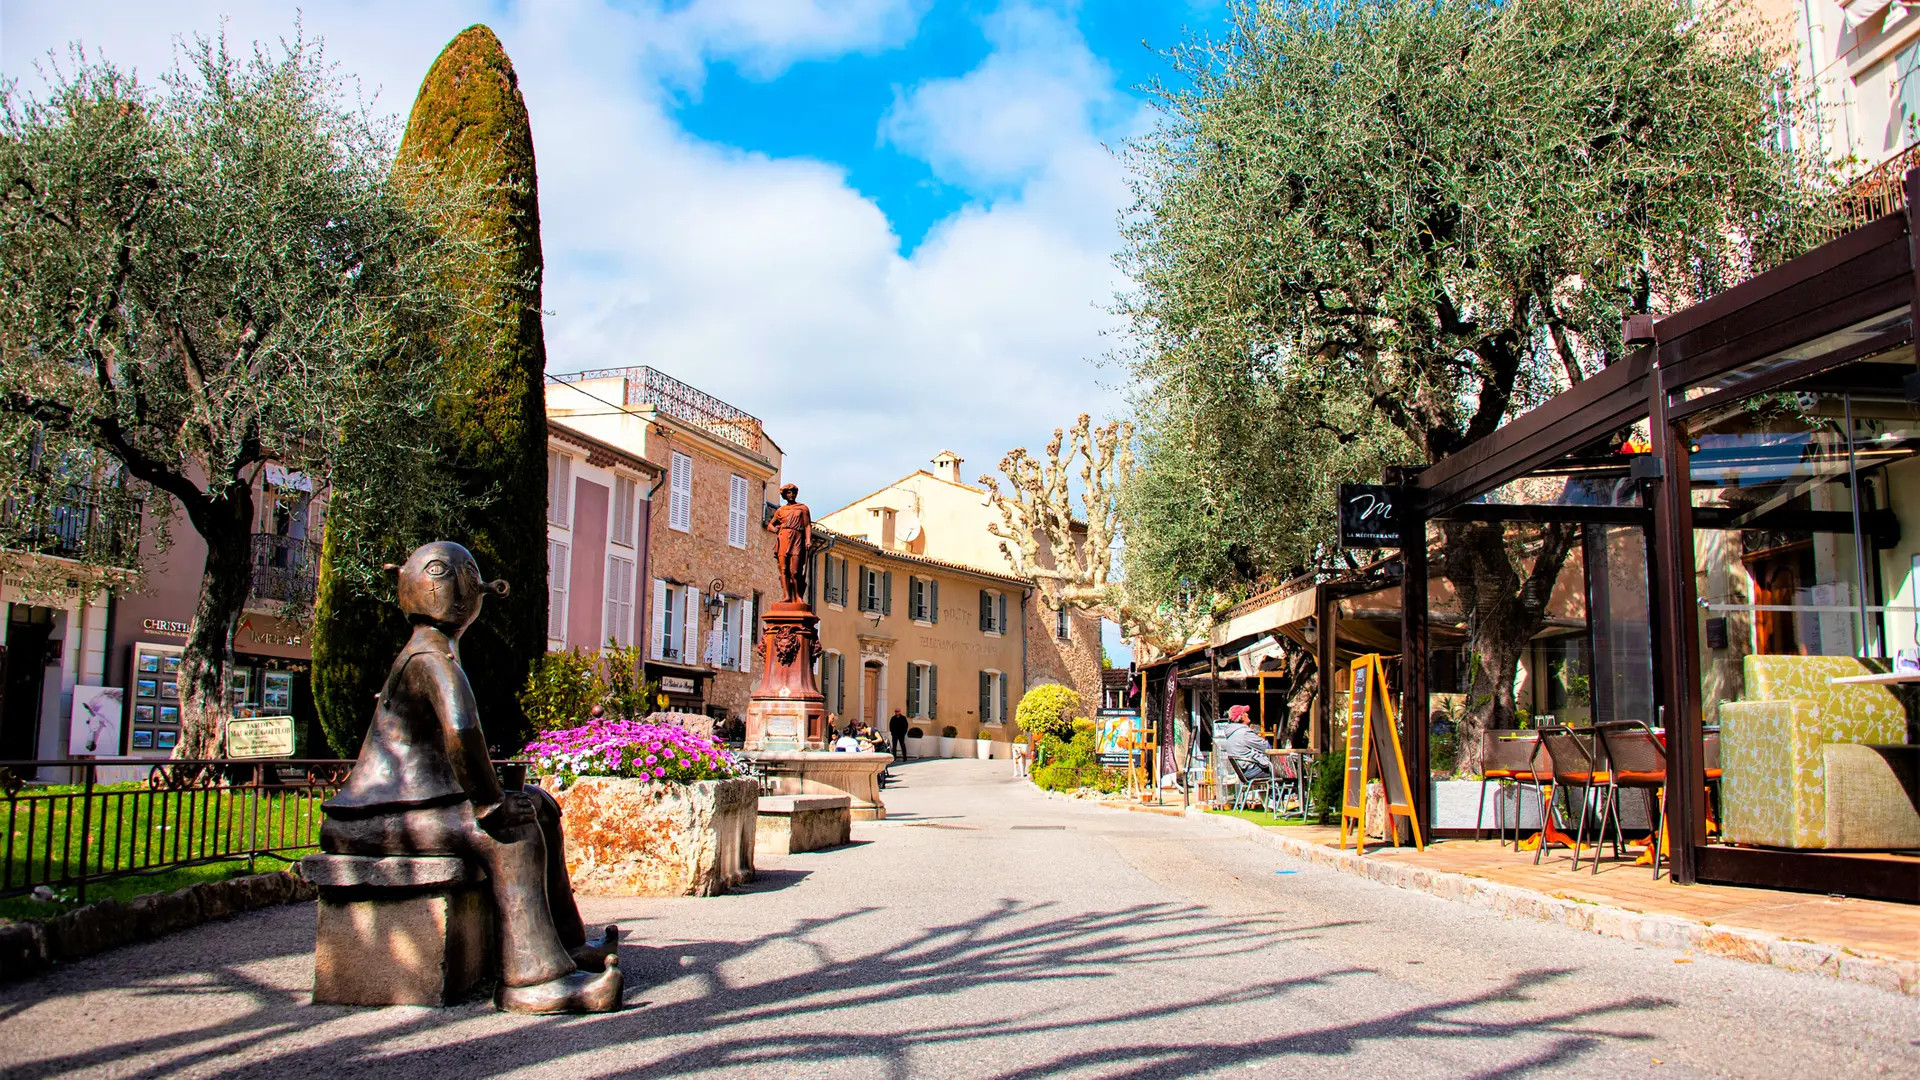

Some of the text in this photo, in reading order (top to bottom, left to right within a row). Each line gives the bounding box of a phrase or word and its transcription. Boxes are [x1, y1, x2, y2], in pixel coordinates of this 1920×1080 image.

[1355, 531, 1399, 539] MÉDITERRANÉE
[247, 721, 274, 729] JARDIN
[230, 729, 259, 737] MAURICE
